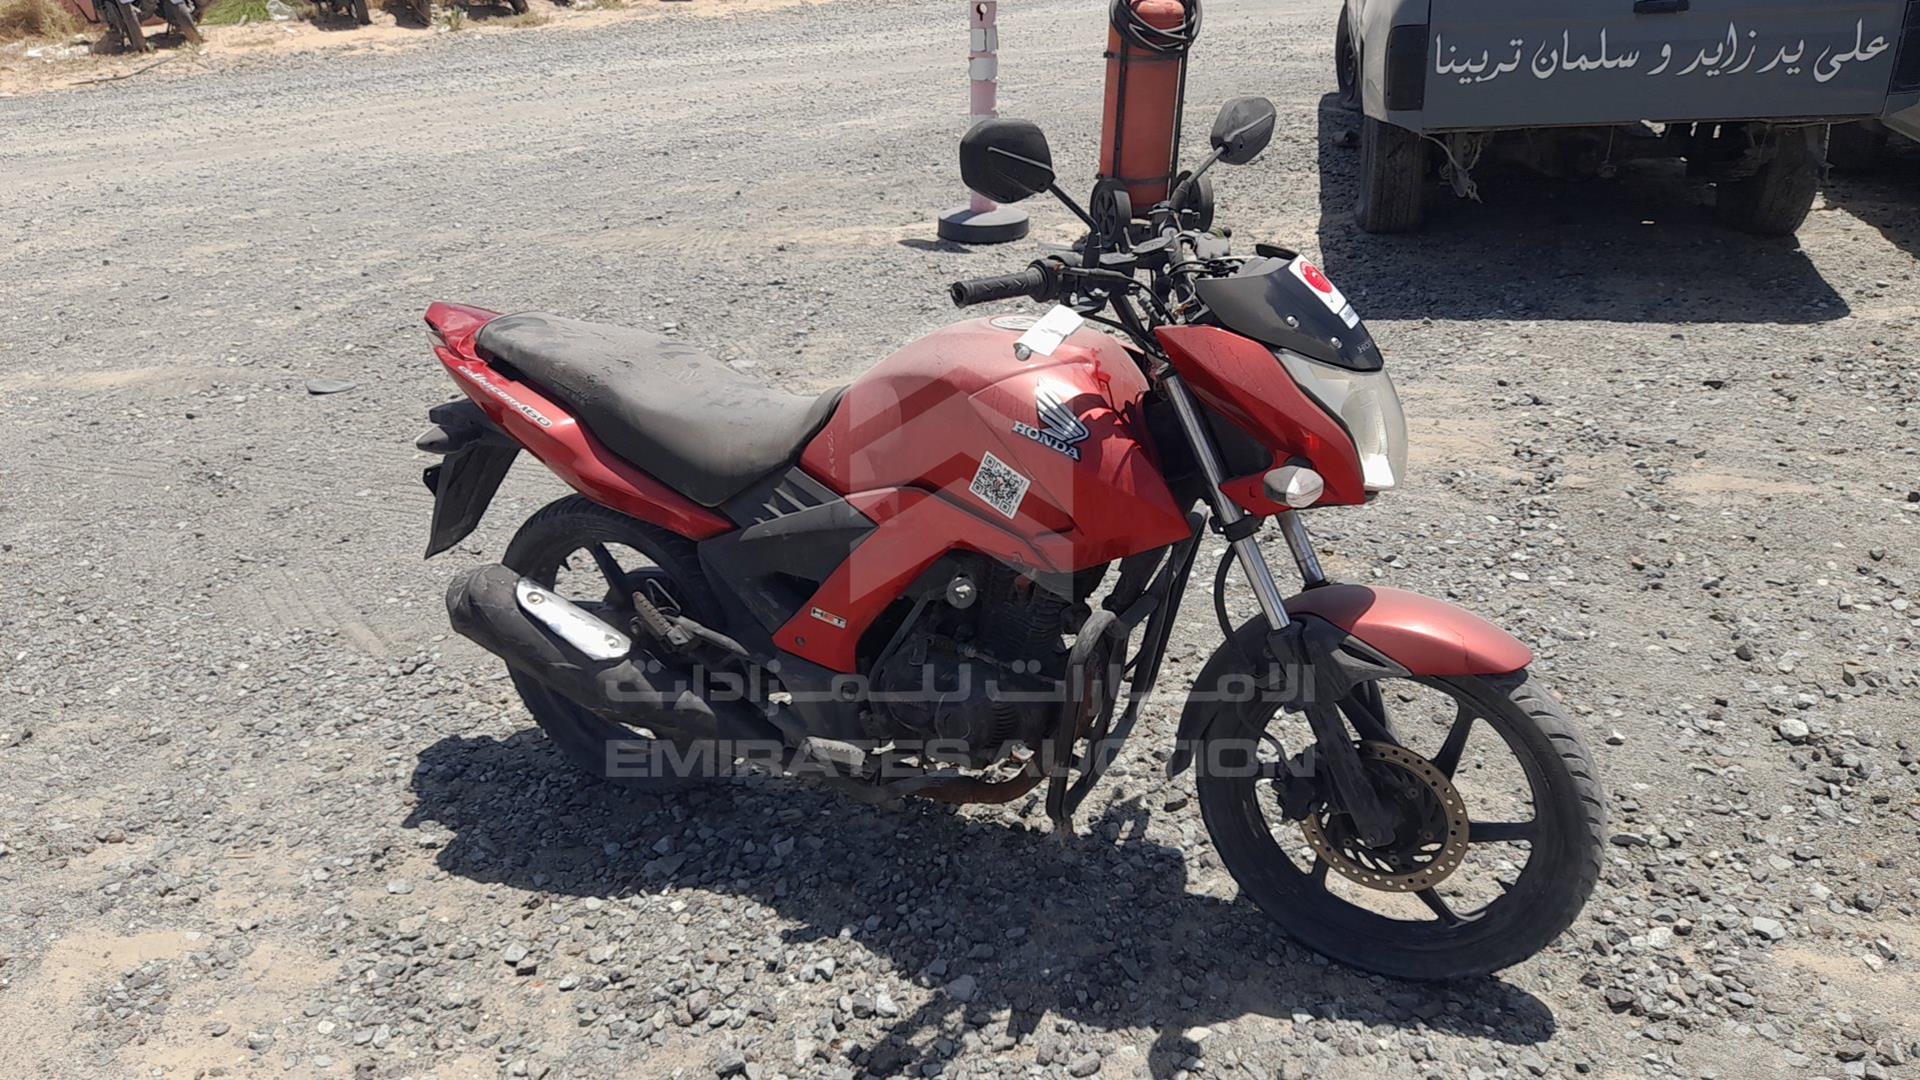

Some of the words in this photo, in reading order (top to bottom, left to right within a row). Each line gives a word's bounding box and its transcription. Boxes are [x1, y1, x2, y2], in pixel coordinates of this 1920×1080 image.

[1436, 34, 1524, 84] تربينا
[1531, 28, 1640, 79] سلمان
[1647, 43, 1672, 75] و
[1678, 22, 1758, 77] زايد
[1756, 39, 1805, 75] يد
[519, 404, 553, 429] 160
[1011, 420, 1081, 461] HONDA
